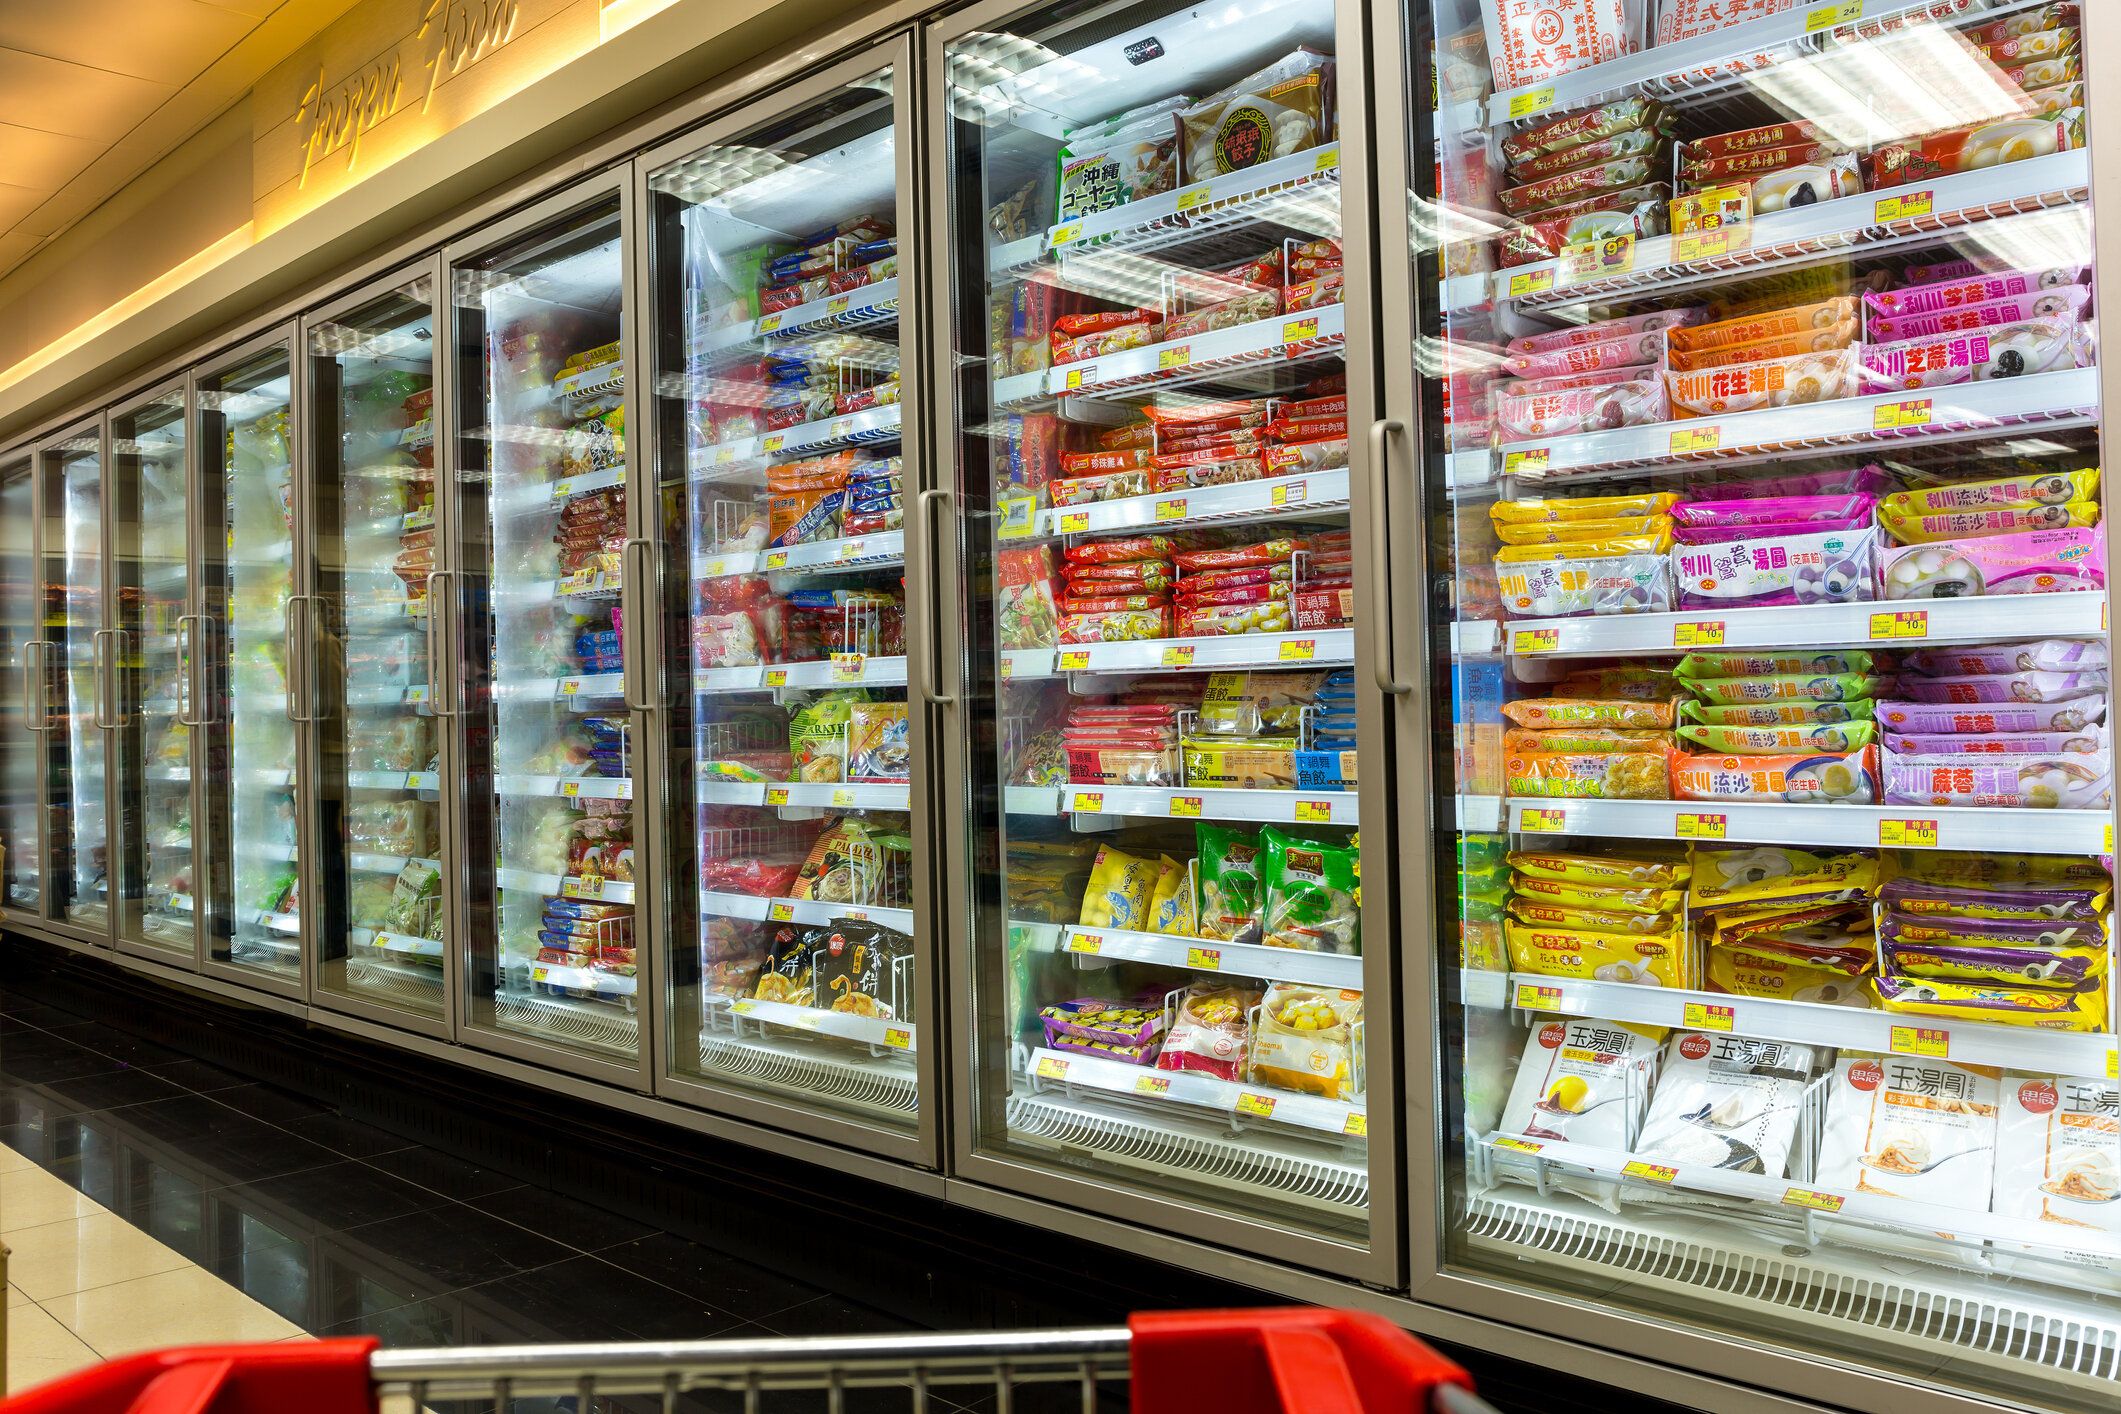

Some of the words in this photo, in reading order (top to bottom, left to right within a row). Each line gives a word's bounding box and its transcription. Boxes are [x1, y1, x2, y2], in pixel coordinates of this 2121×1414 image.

[1677, 366, 1785, 402] 利川花生湯圓
[1296, 756, 1331, 770] 下鍋舞
[1299, 770, 1326, 786] 魚餃
[1678, 771, 1787, 794] 利川流沙湯圓
[1711, 1006, 1730, 1016] 特價
[1567, 1026, 1629, 1055] 玉湯圓
[1922, 1030, 1944, 1040] 特價
[1712, 1037, 1783, 1066] 玉湯圓
[1888, 1065, 1968, 1101] 玉湯圓
